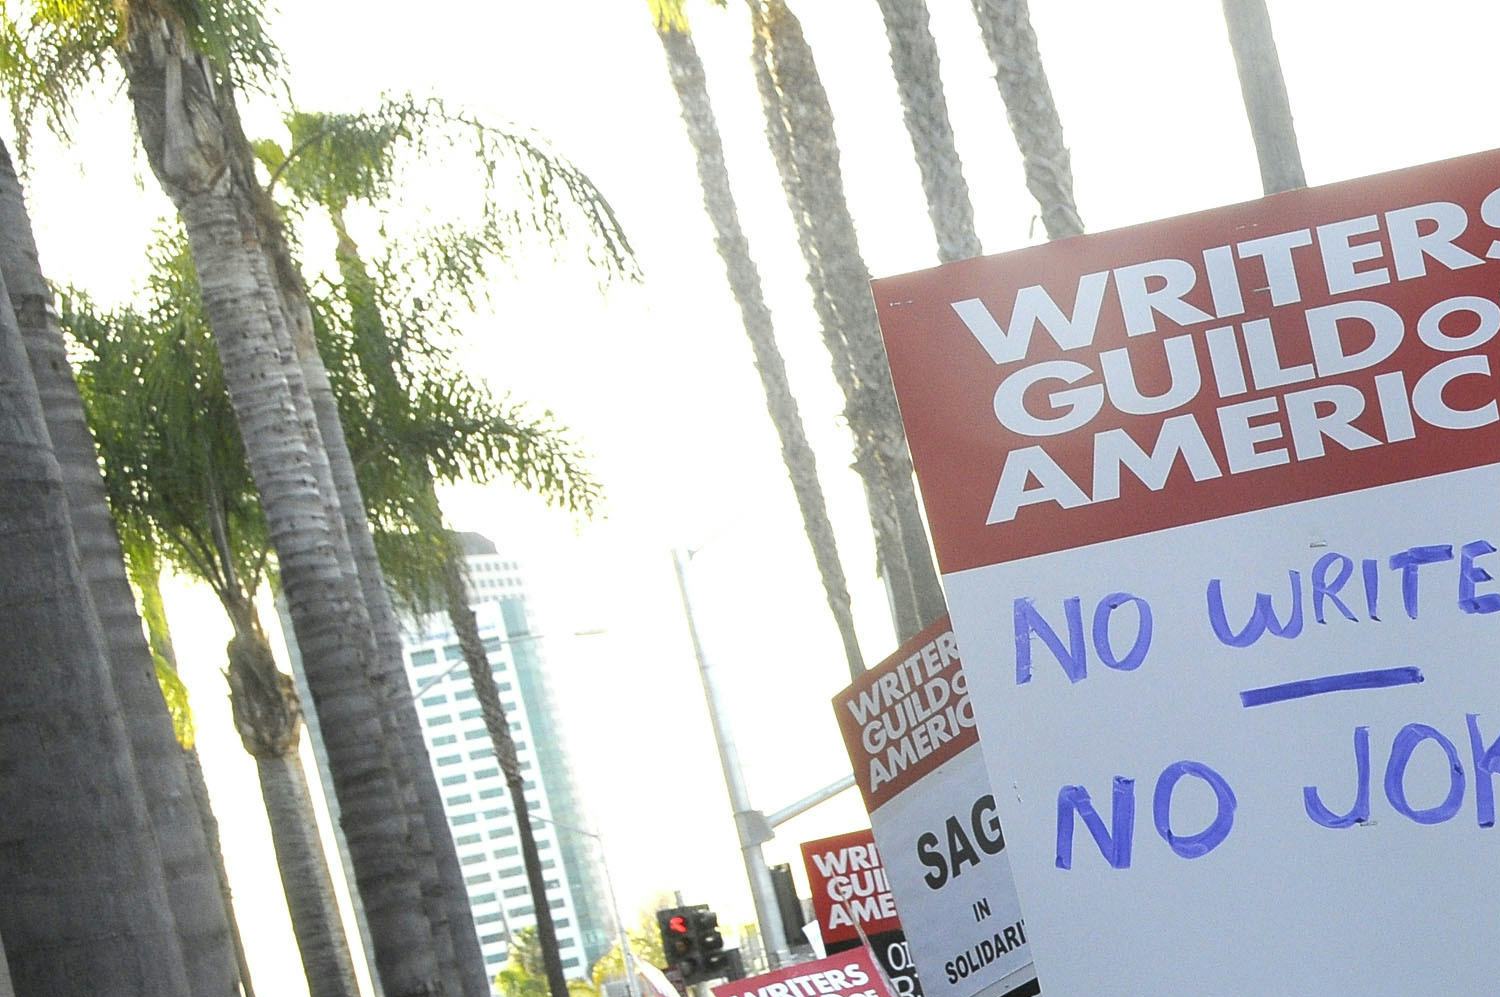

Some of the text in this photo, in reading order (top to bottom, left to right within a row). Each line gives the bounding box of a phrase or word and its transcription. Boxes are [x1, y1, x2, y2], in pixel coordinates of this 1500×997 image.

[993, 300, 1405, 436] GUILD
[847, 631, 960, 726] WRITER
[1012, 592, 1153, 684] NO
[862, 669, 968, 754] GUILD O
[869, 696, 976, 794] AMERIC
[812, 843, 879, 878] WRI
[917, 794, 1006, 890] SAG
[1055, 760, 1238, 869] NO
[829, 893, 897, 929] AME
[945, 919, 1027, 985] SOLIDARI
[972, 898, 992, 922] IN
